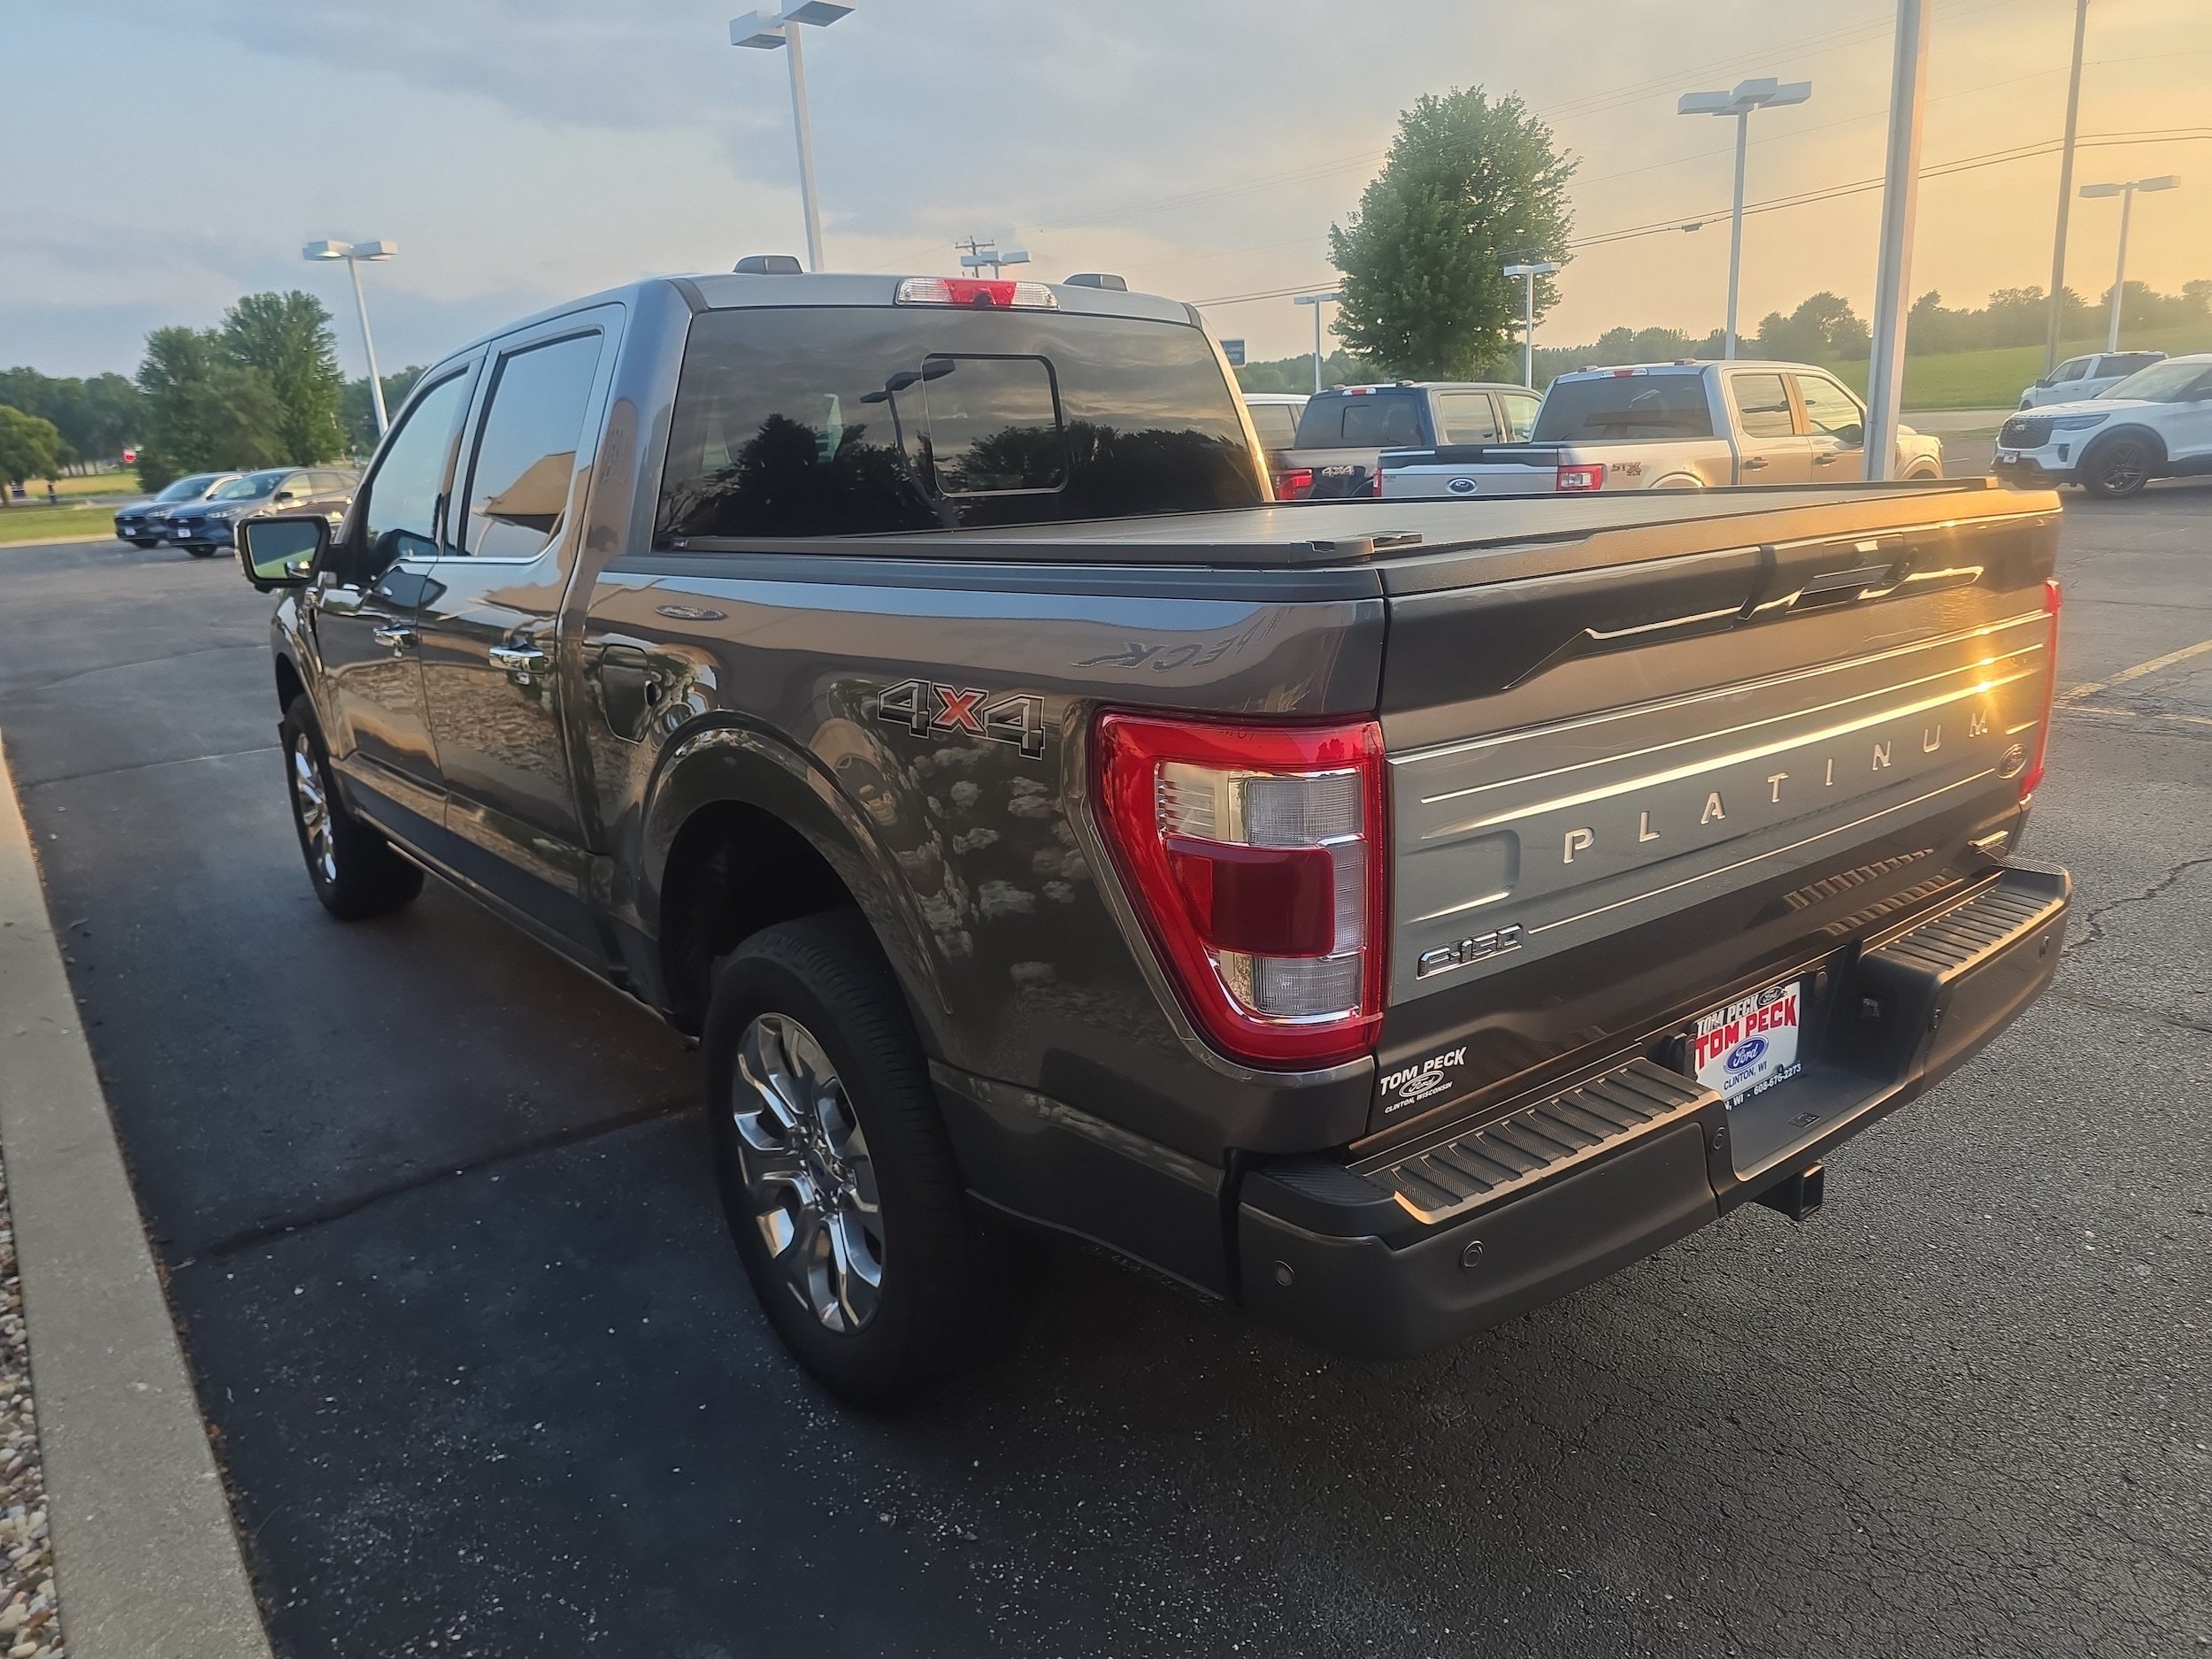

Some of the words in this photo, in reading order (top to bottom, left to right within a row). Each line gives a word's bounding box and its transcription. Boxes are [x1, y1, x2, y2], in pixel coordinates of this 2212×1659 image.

[1563, 709, 1989, 864] PLATINUM
[1416, 923, 1523, 980] F-150
[1726, 994, 1760, 1024] PECK
[1695, 1021, 1740, 1071] TOM
[1746, 995, 1797, 1039] PECK
[1732, 1042, 1760, 1067] Ford
[1380, 1065, 1418, 1096] TOM
[1423, 1046, 1467, 1073] PECK
[1408, 1076, 1435, 1093] Ford
[1724, 1067, 1756, 1090] CLINTON,
[1758, 1061, 1767, 1072] WI
[1384, 1097, 1416, 1114] CLINTON,
[1417, 1081, 1453, 1102] WISCONSIN
[1733, 1094, 1743, 1106] WI
